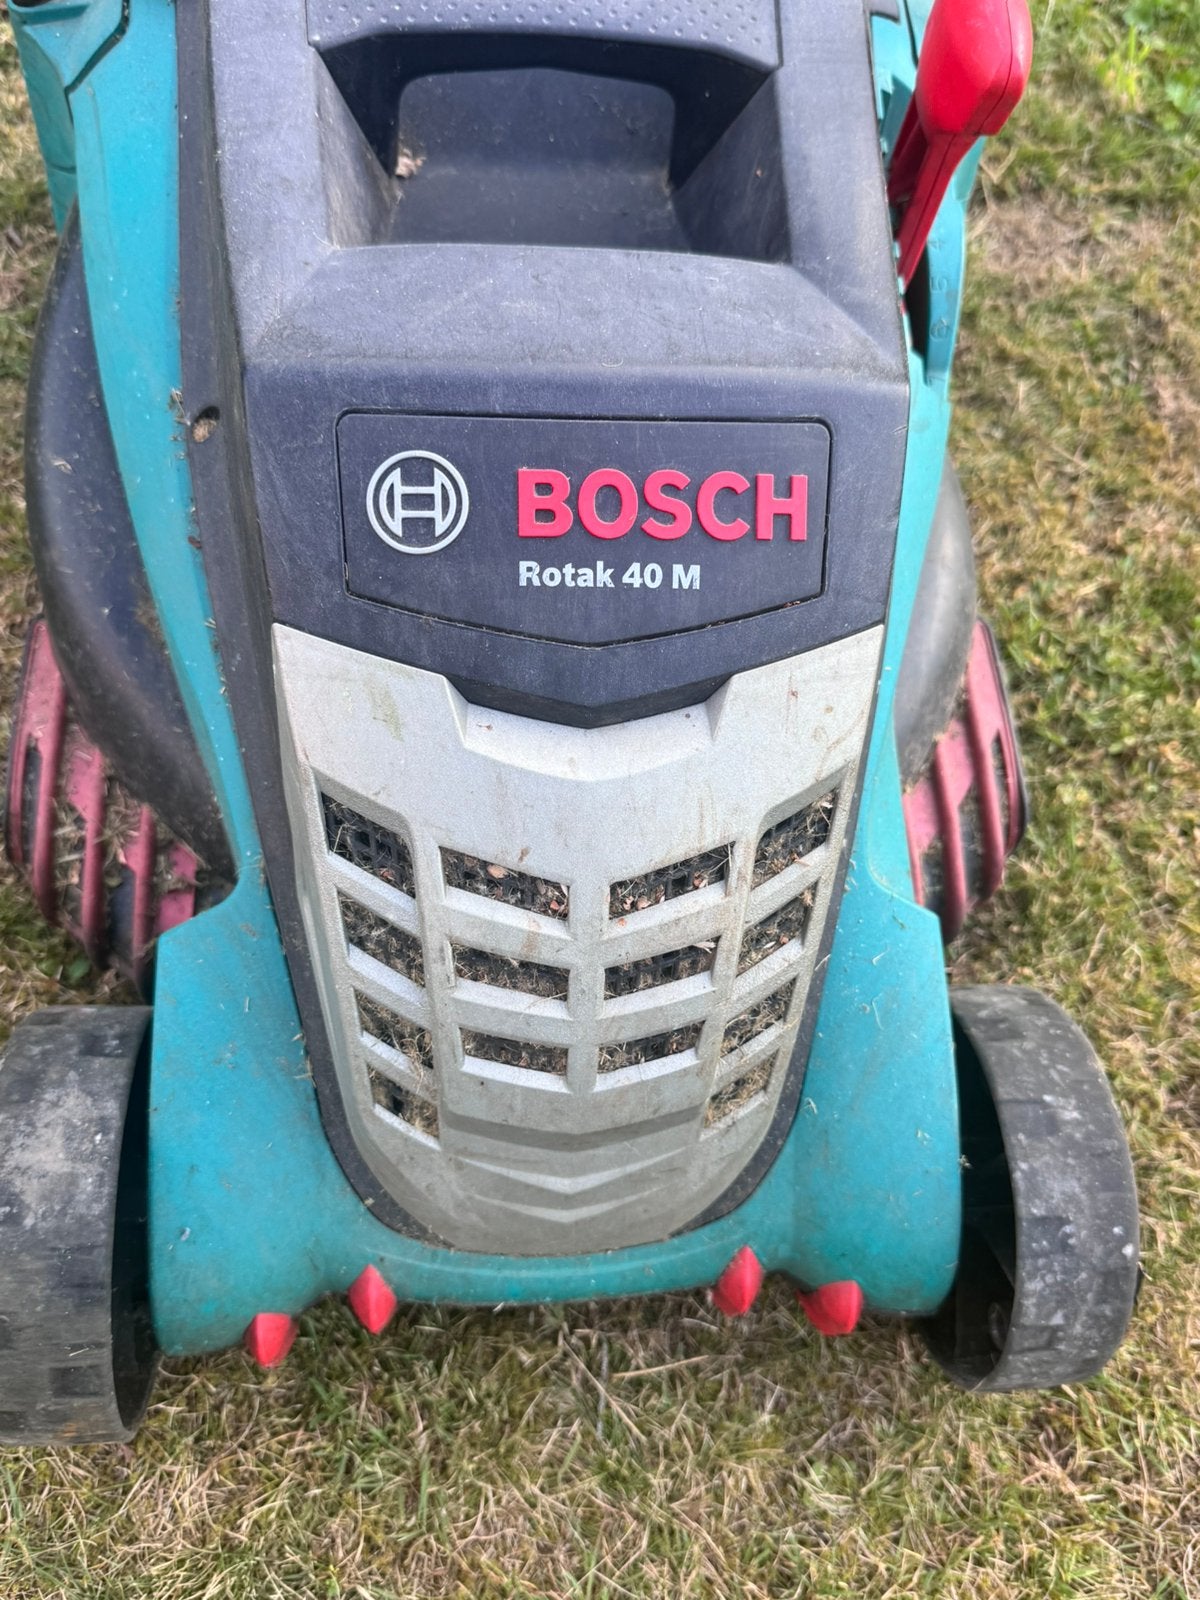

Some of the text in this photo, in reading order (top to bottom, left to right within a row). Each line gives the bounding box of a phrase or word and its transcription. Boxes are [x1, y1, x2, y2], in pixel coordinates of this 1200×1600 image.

[517, 467, 808, 541] BOSCH
[519, 561, 701, 590] Rotak 40 M
